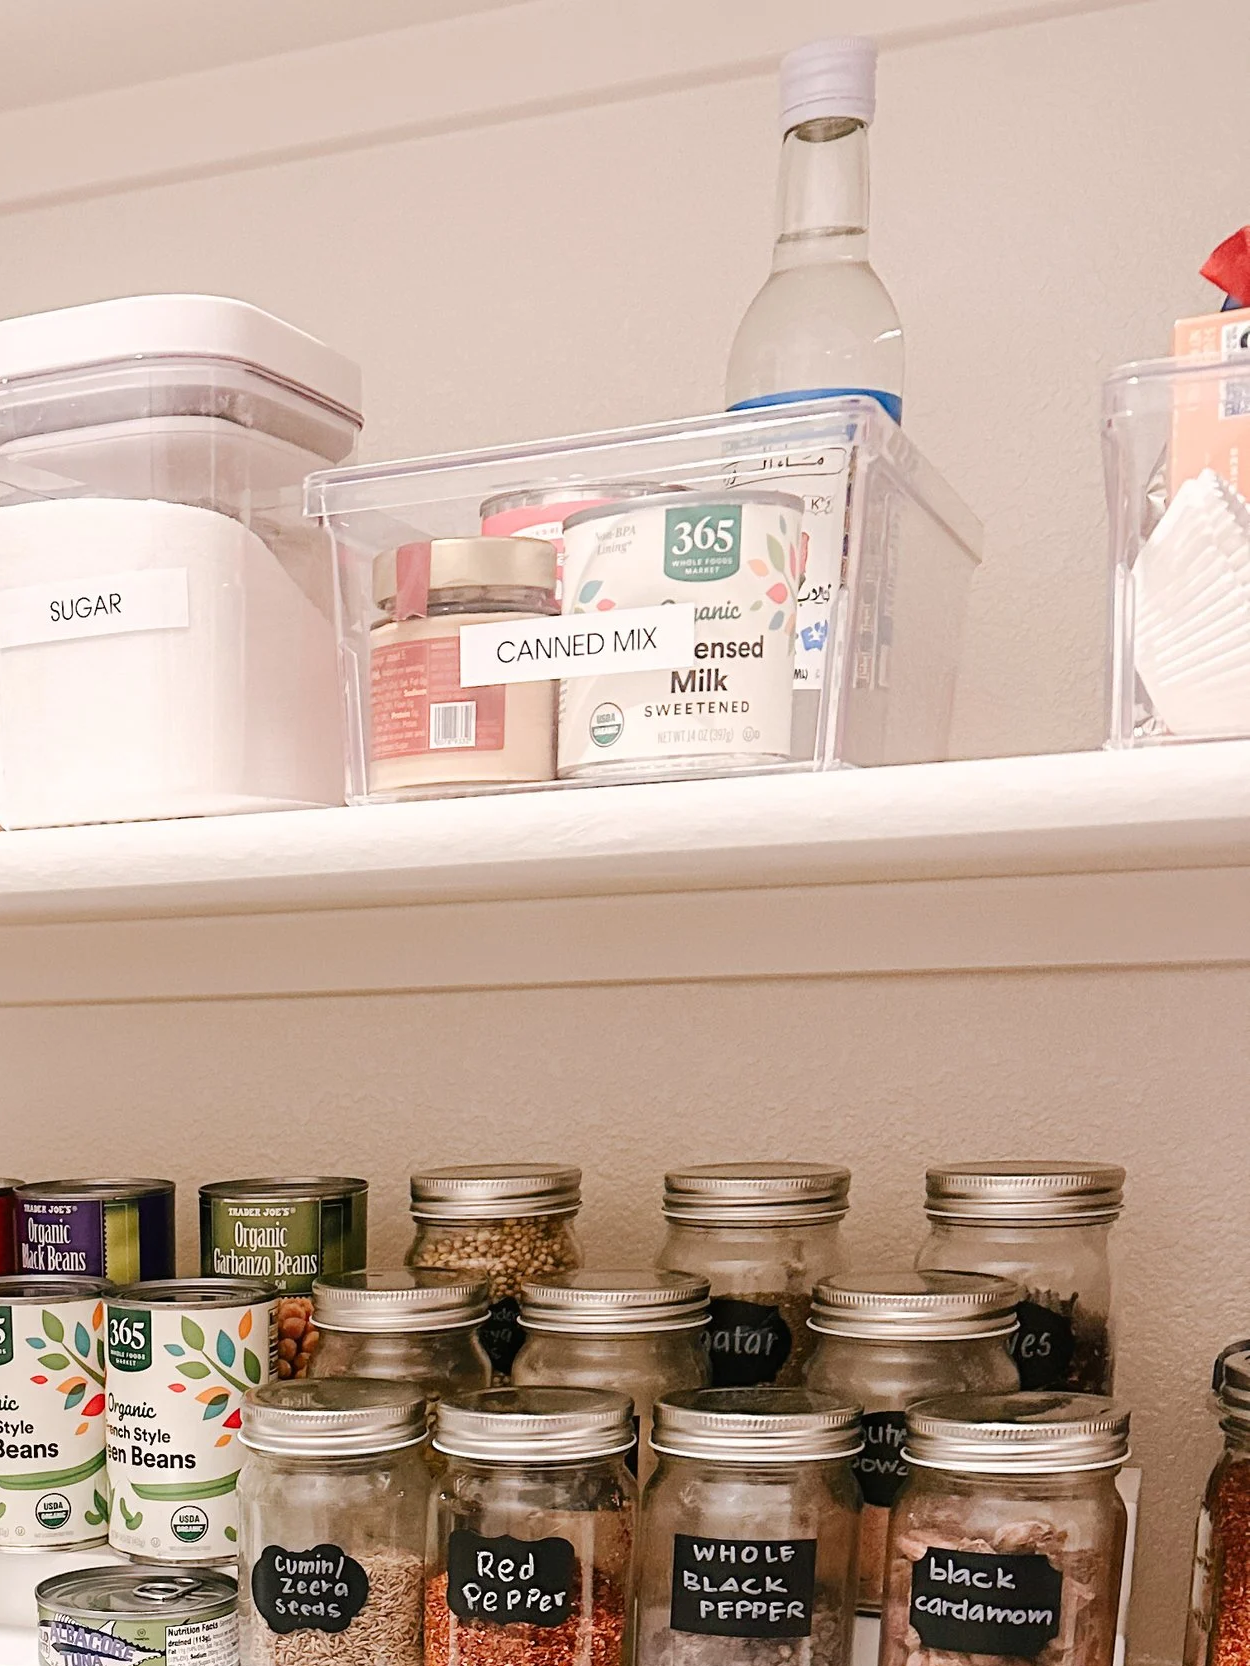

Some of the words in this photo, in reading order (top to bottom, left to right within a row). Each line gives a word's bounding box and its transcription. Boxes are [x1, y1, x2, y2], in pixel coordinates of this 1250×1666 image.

[672, 516, 734, 555] 365
[685, 566, 720, 575] MARKET
[50, 593, 121, 622] SUGAR
[497, 633, 605, 664] CANNED
[614, 627, 657, 650] MIX
[670, 669, 728, 694] Milk
[597, 713, 617, 724] USDA
[644, 701, 750, 718] SWEETENED
[24, 1204, 47, 1213] TRADER
[48, 1205, 72, 1214] JOE'S
[228, 1207, 261, 1217] TRADER
[263, 1207, 290, 1217] JOE'S
[28, 1217, 71, 1247] Organic
[234, 1221, 288, 1248] Organic
[47, 1246, 86, 1272] Beans
[213, 1247, 271, 1277] Garbanzo
[273, 1248, 318, 1276] Beans
[110, 1317, 145, 1350] 365
[127, 1352, 146, 1360] FOODS
[108, 1393, 156, 1421] Organic
[134, 1427, 171, 1445] Style
[131, 1446, 196, 1470] Beans
[43, 1502, 63, 1511] USDA
[179, 1515, 200, 1523] USDA
[692, 1543, 796, 1563] WHOLE
[476, 1550, 535, 1583] Red
[929, 1558, 1017, 1591] black
[683, 1572, 788, 1594] BLACK
[700, 1601, 805, 1621] PEPPER
[914, 1594, 1053, 1627] cardamom
[50, 1622, 137, 1662] ALBACORE
[168, 1627, 200, 1637] Nutrition
[202, 1623, 219, 1633] Facts
[168, 1639, 191, 1648] drained
